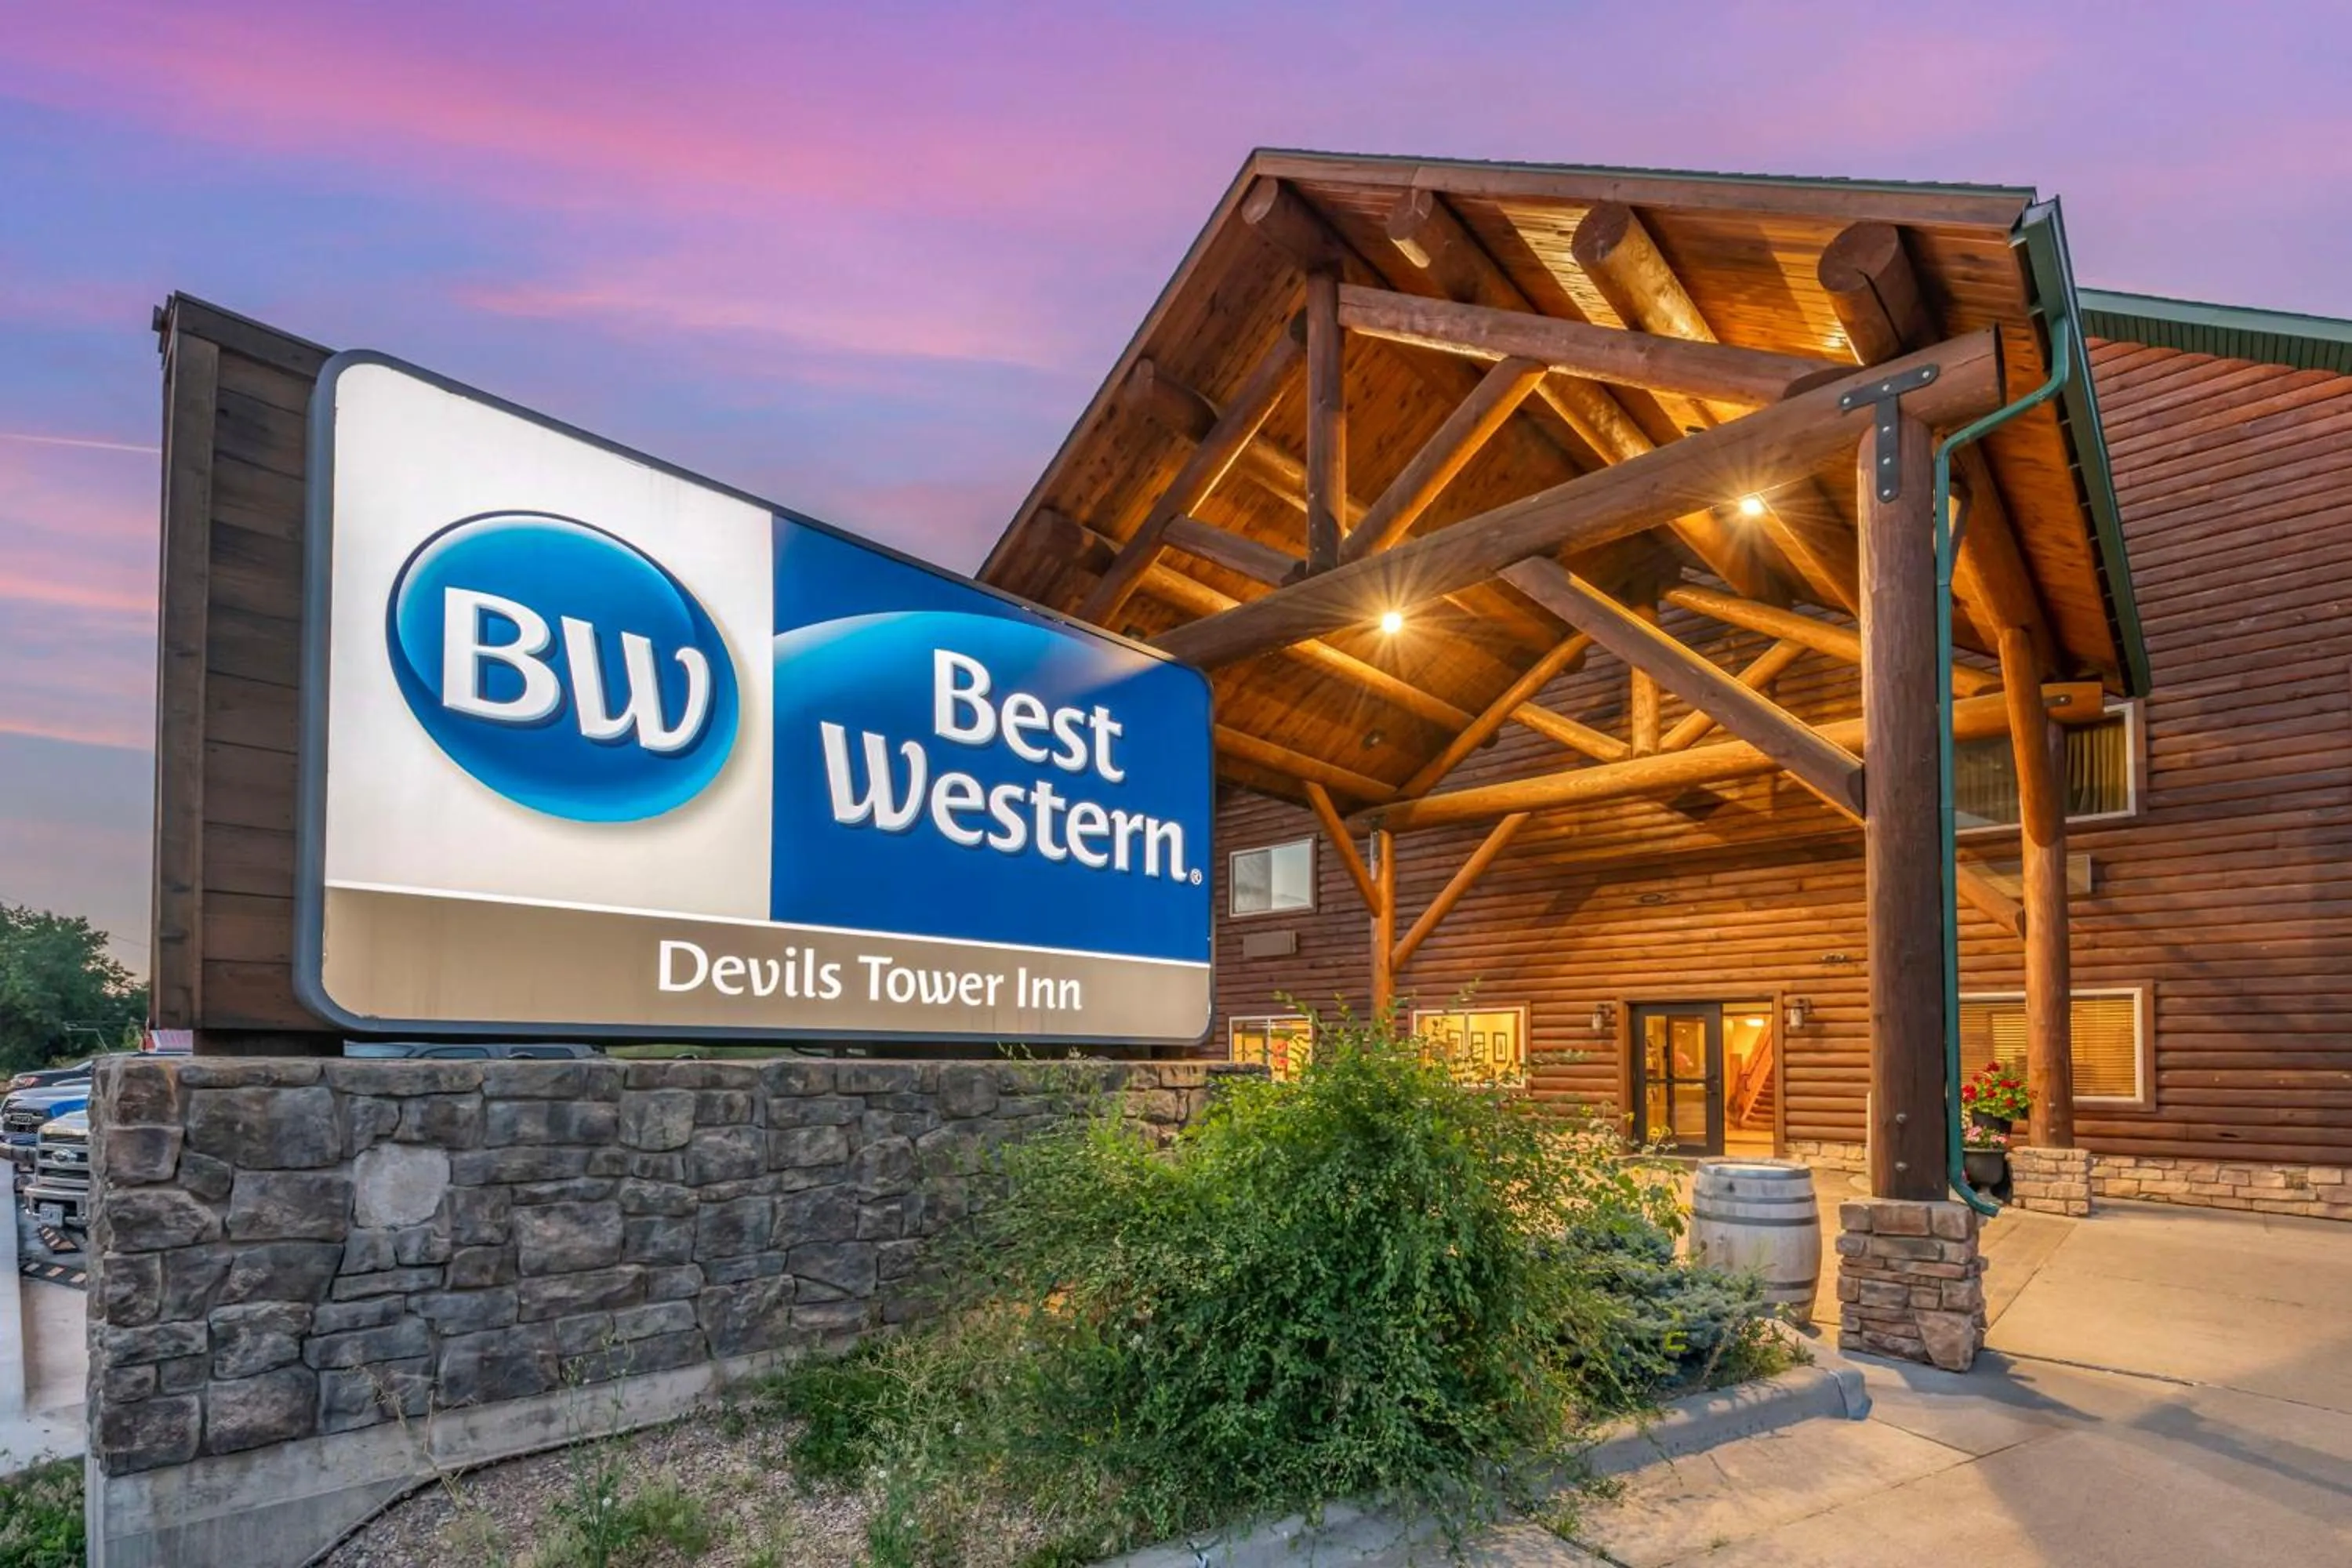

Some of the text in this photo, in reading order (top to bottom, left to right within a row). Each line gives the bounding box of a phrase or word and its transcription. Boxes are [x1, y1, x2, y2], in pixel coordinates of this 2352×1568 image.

[443, 586, 710, 753] BW
[934, 649, 1125, 783] Best
[658, 939, 1083, 1011] Devils Tower Inn
